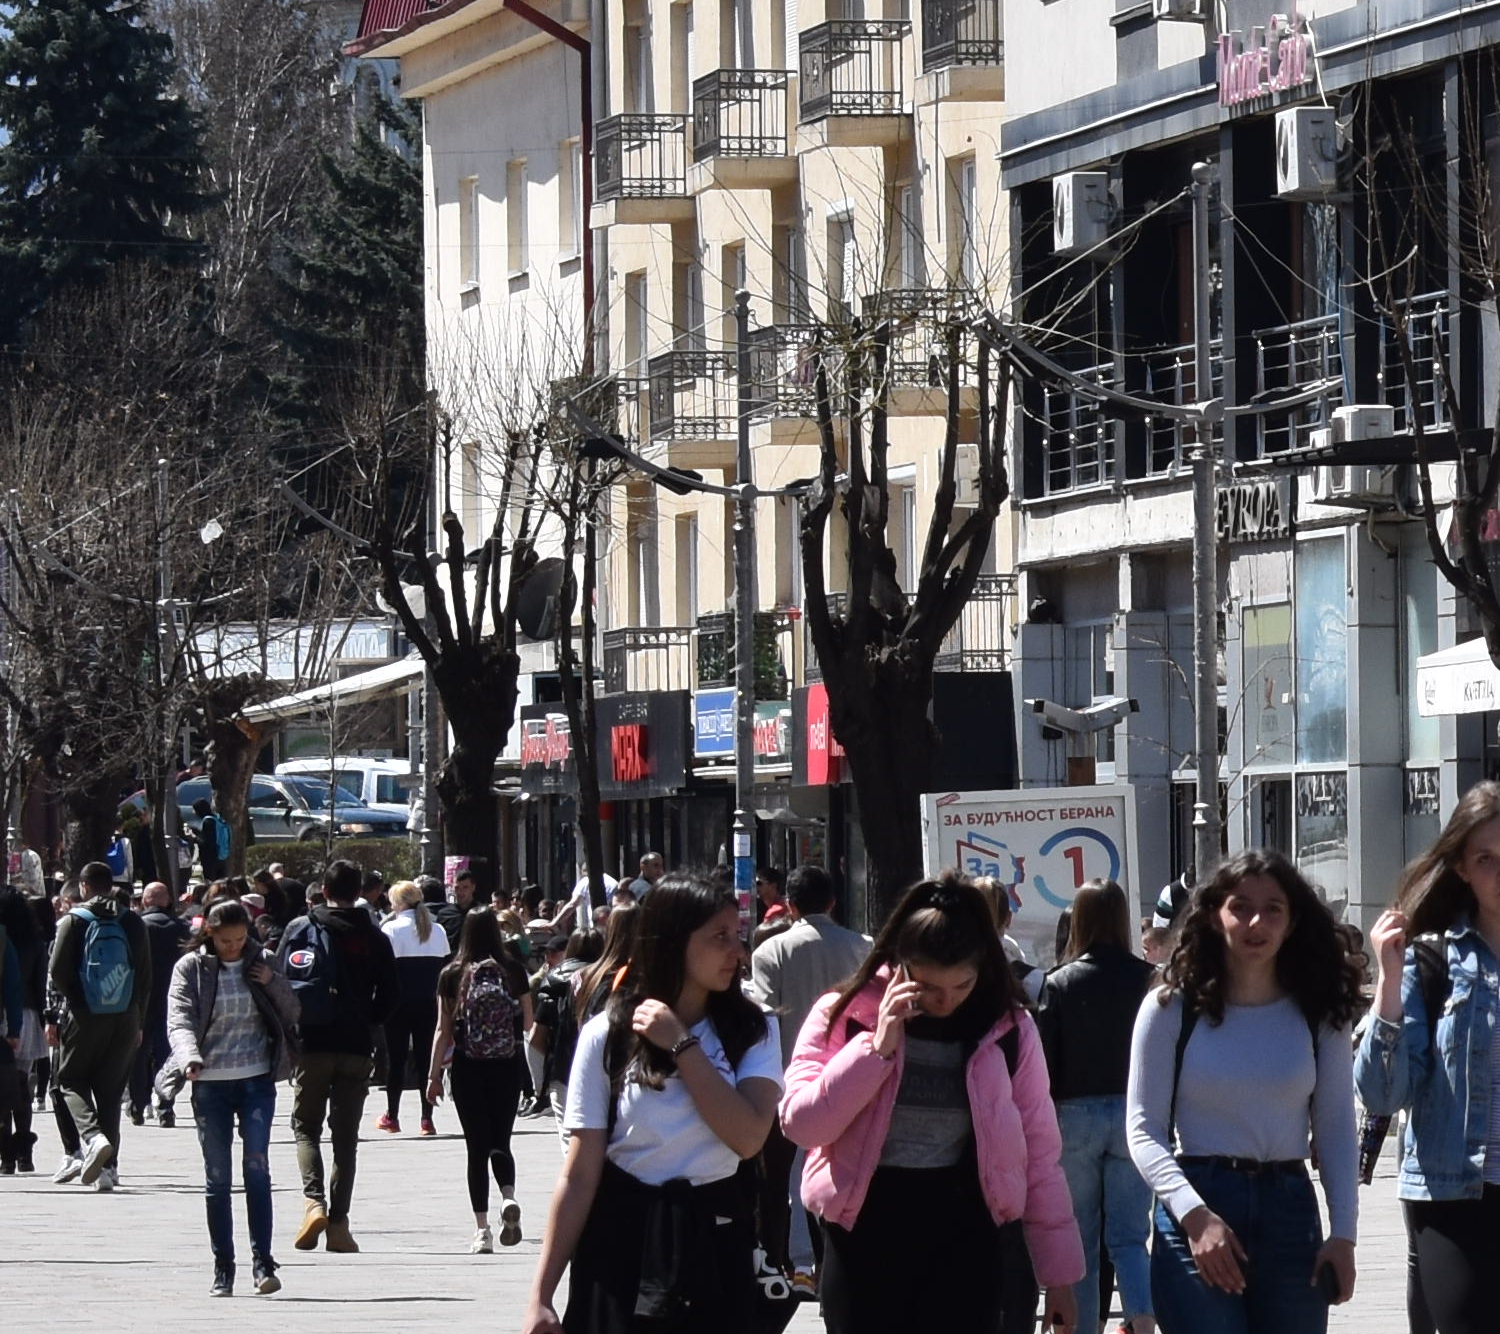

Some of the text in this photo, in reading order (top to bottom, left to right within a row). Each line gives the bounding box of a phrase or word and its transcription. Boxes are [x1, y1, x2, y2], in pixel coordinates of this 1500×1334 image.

[943, 805, 1115, 828] ЗА БУДУЋНОСТ БЕРАНА
[1063, 846, 1085, 889] 1
[100, 964, 129, 996] NIKE
